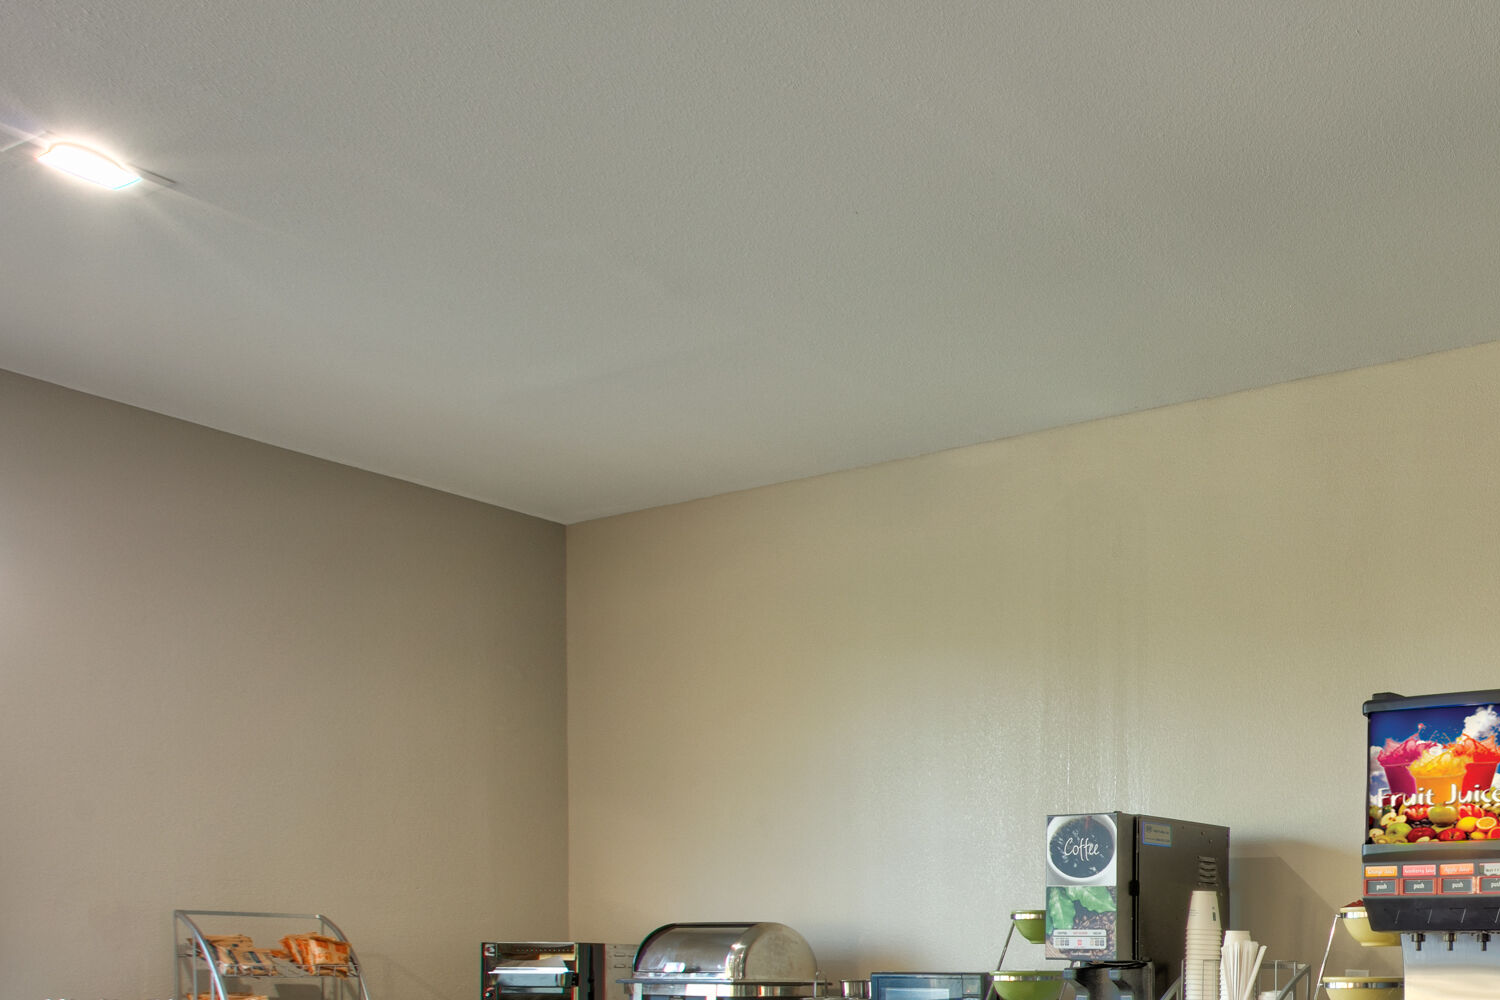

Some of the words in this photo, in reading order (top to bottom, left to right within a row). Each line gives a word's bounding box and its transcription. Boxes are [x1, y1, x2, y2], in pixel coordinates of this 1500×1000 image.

[1377, 787, 1435, 808] Fruit
[1064, 837, 1100, 862] Coffee
[1452, 881, 1464, 889] push
